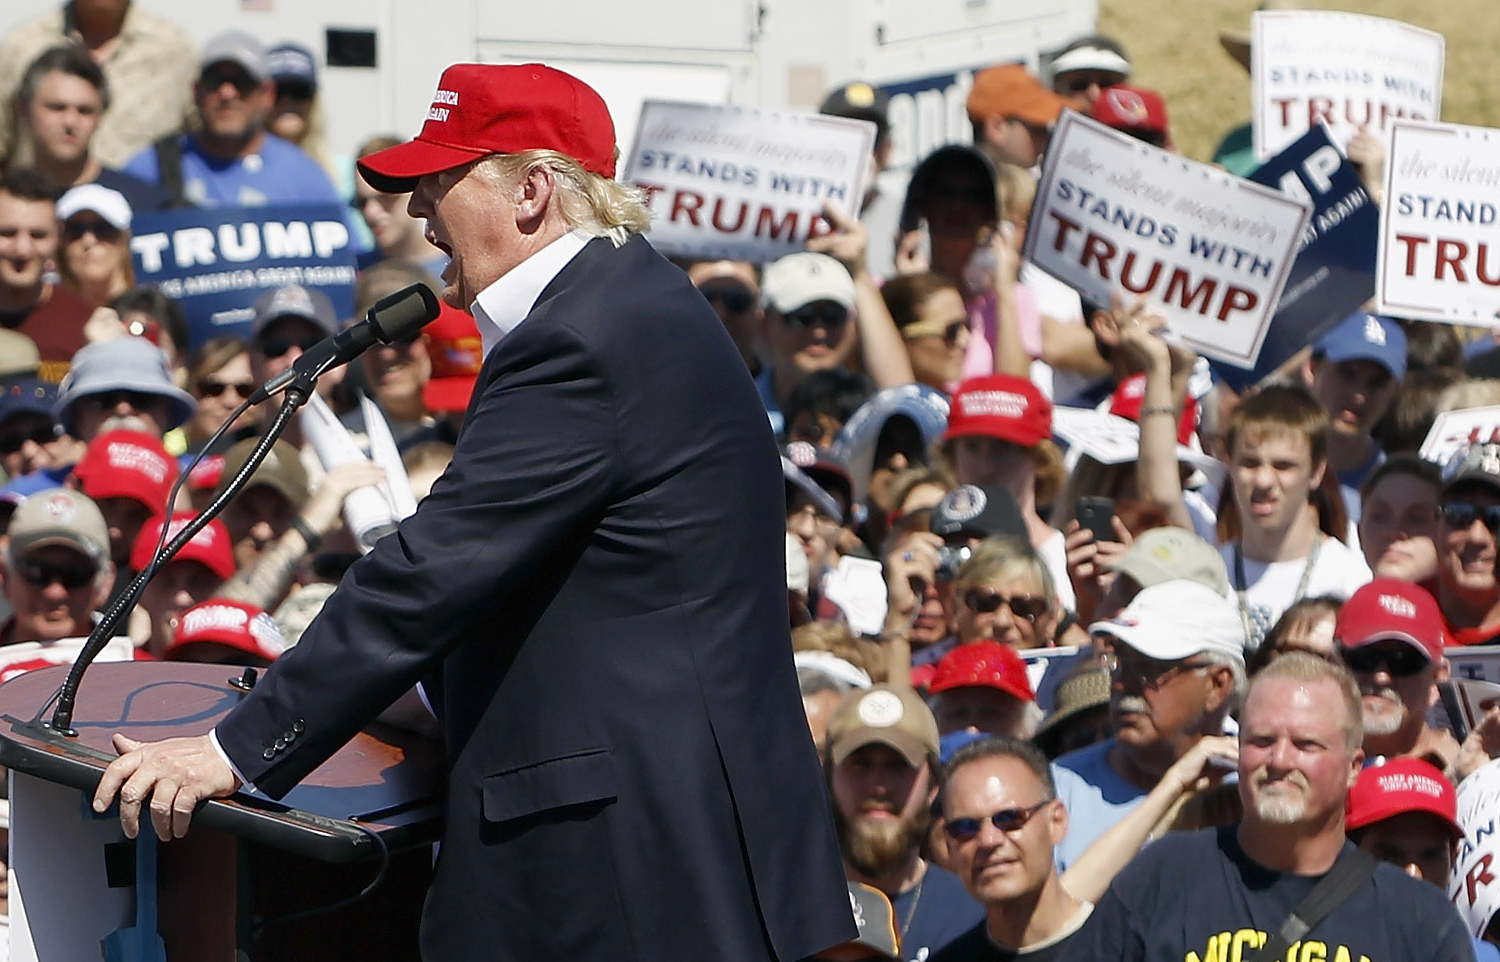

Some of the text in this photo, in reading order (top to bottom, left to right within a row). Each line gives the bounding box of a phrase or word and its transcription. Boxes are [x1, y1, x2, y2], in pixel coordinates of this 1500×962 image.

[640, 150, 847, 201] STANDS WITH
[130, 220, 350, 274] TRUMP
[1049, 210, 1260, 322] TRUMP
[1057, 178, 1275, 278] STANDS WITH
